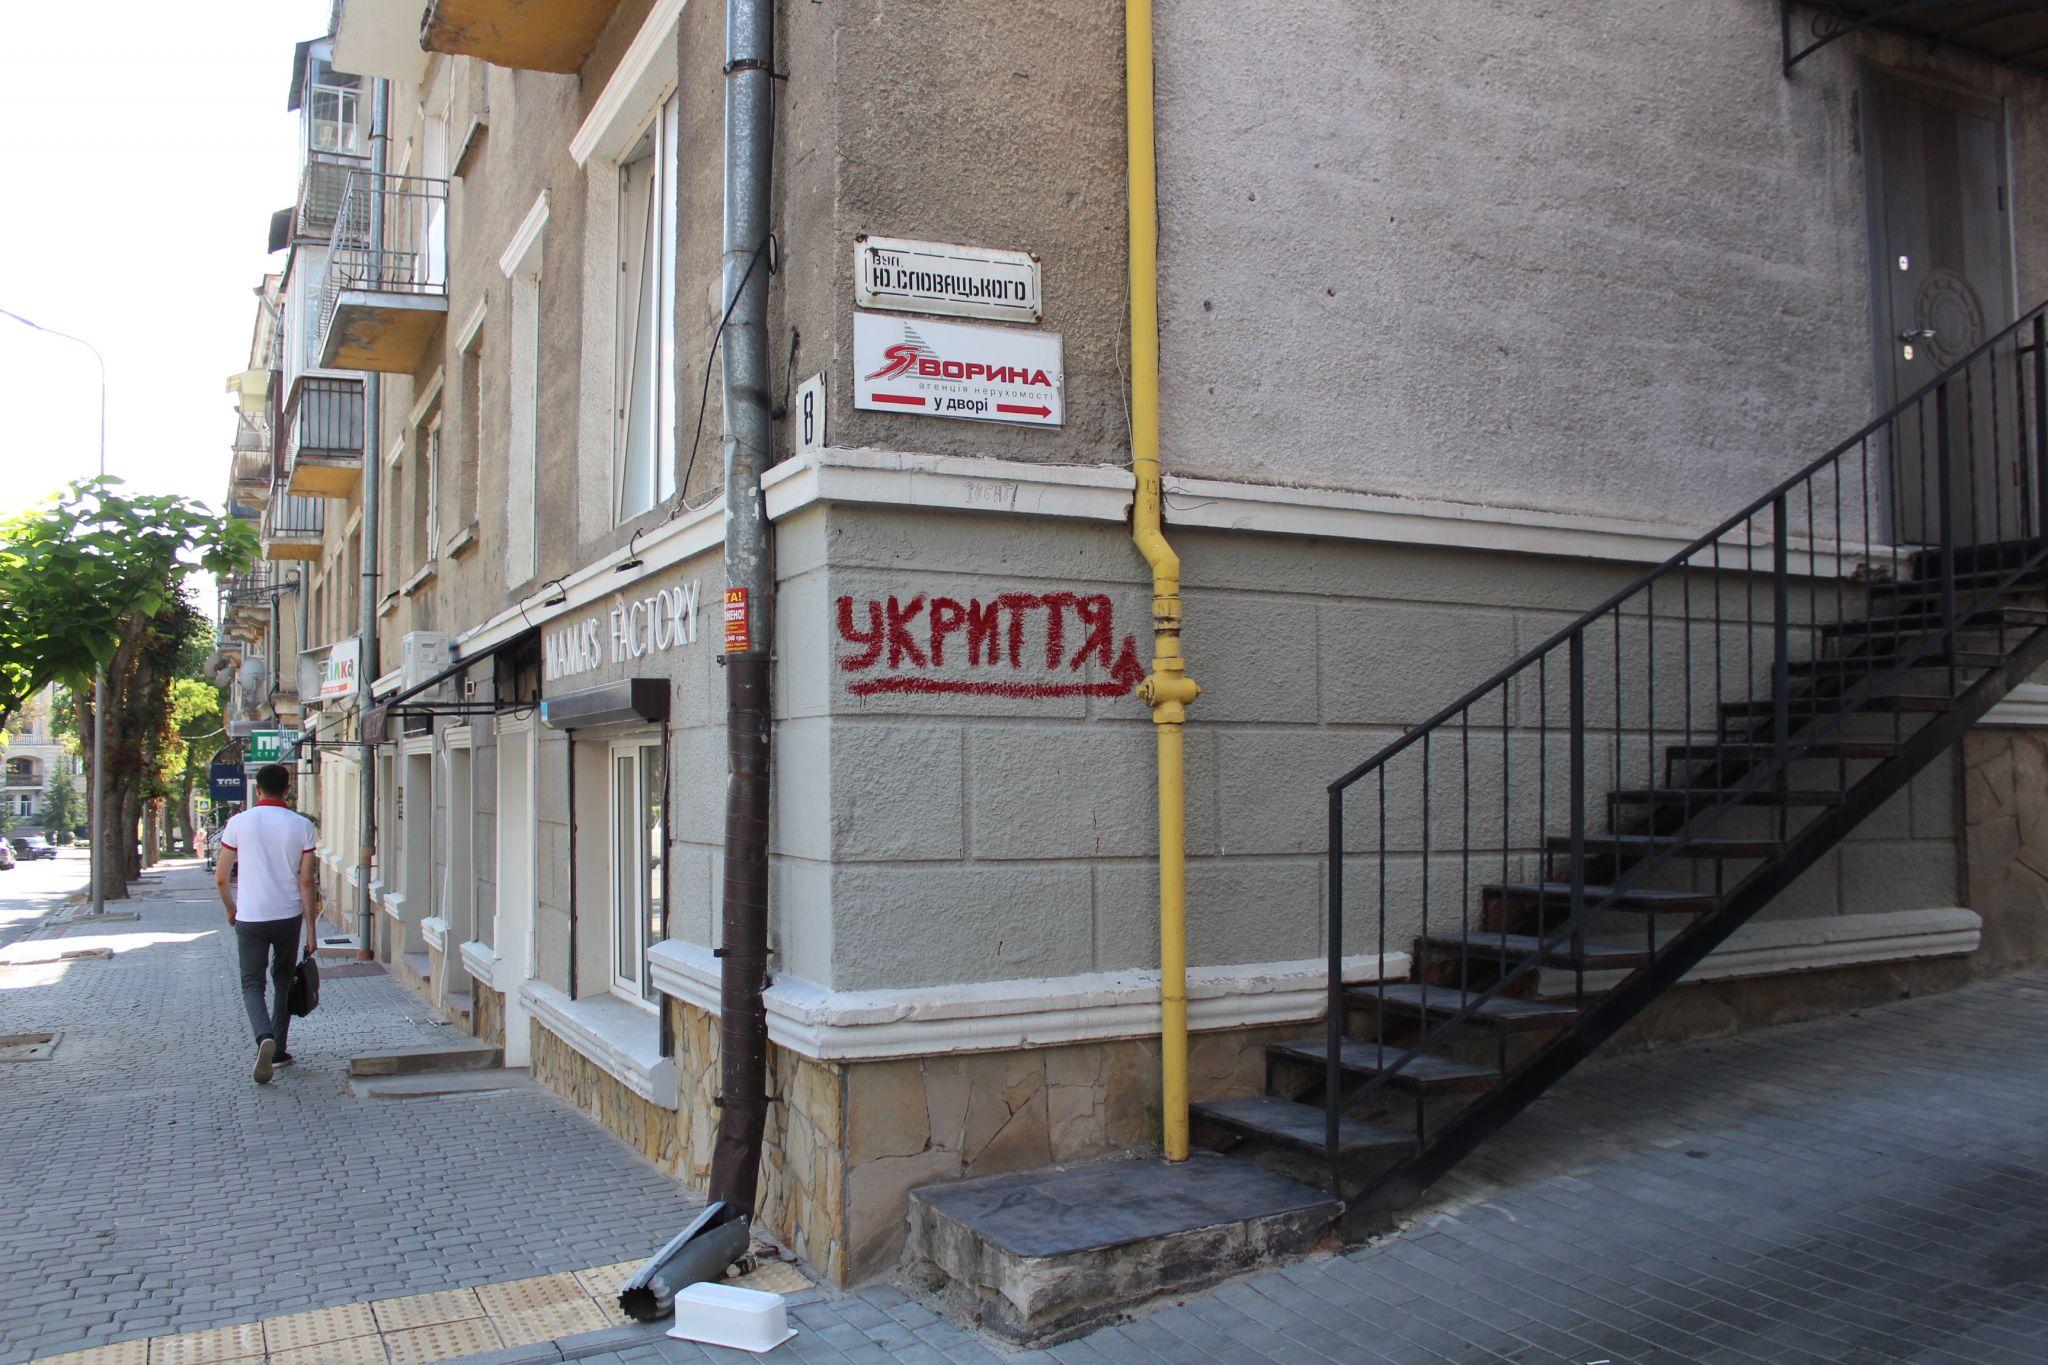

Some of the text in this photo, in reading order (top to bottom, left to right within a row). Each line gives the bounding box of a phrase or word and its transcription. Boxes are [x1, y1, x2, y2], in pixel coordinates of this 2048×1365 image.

[873, 267, 1026, 301] Ю.СЛОВАЦЬКОГО
[865, 343, 1052, 387] ЯВОРИНА
[919, 383, 1053, 401] агенція нерухомості
[933, 397, 989, 414] у дворі
[804, 390, 814, 445] 8
[545, 579, 702, 681] MAMA'S FACTORY
[836, 591, 1113, 672] УКРИТТЯ
